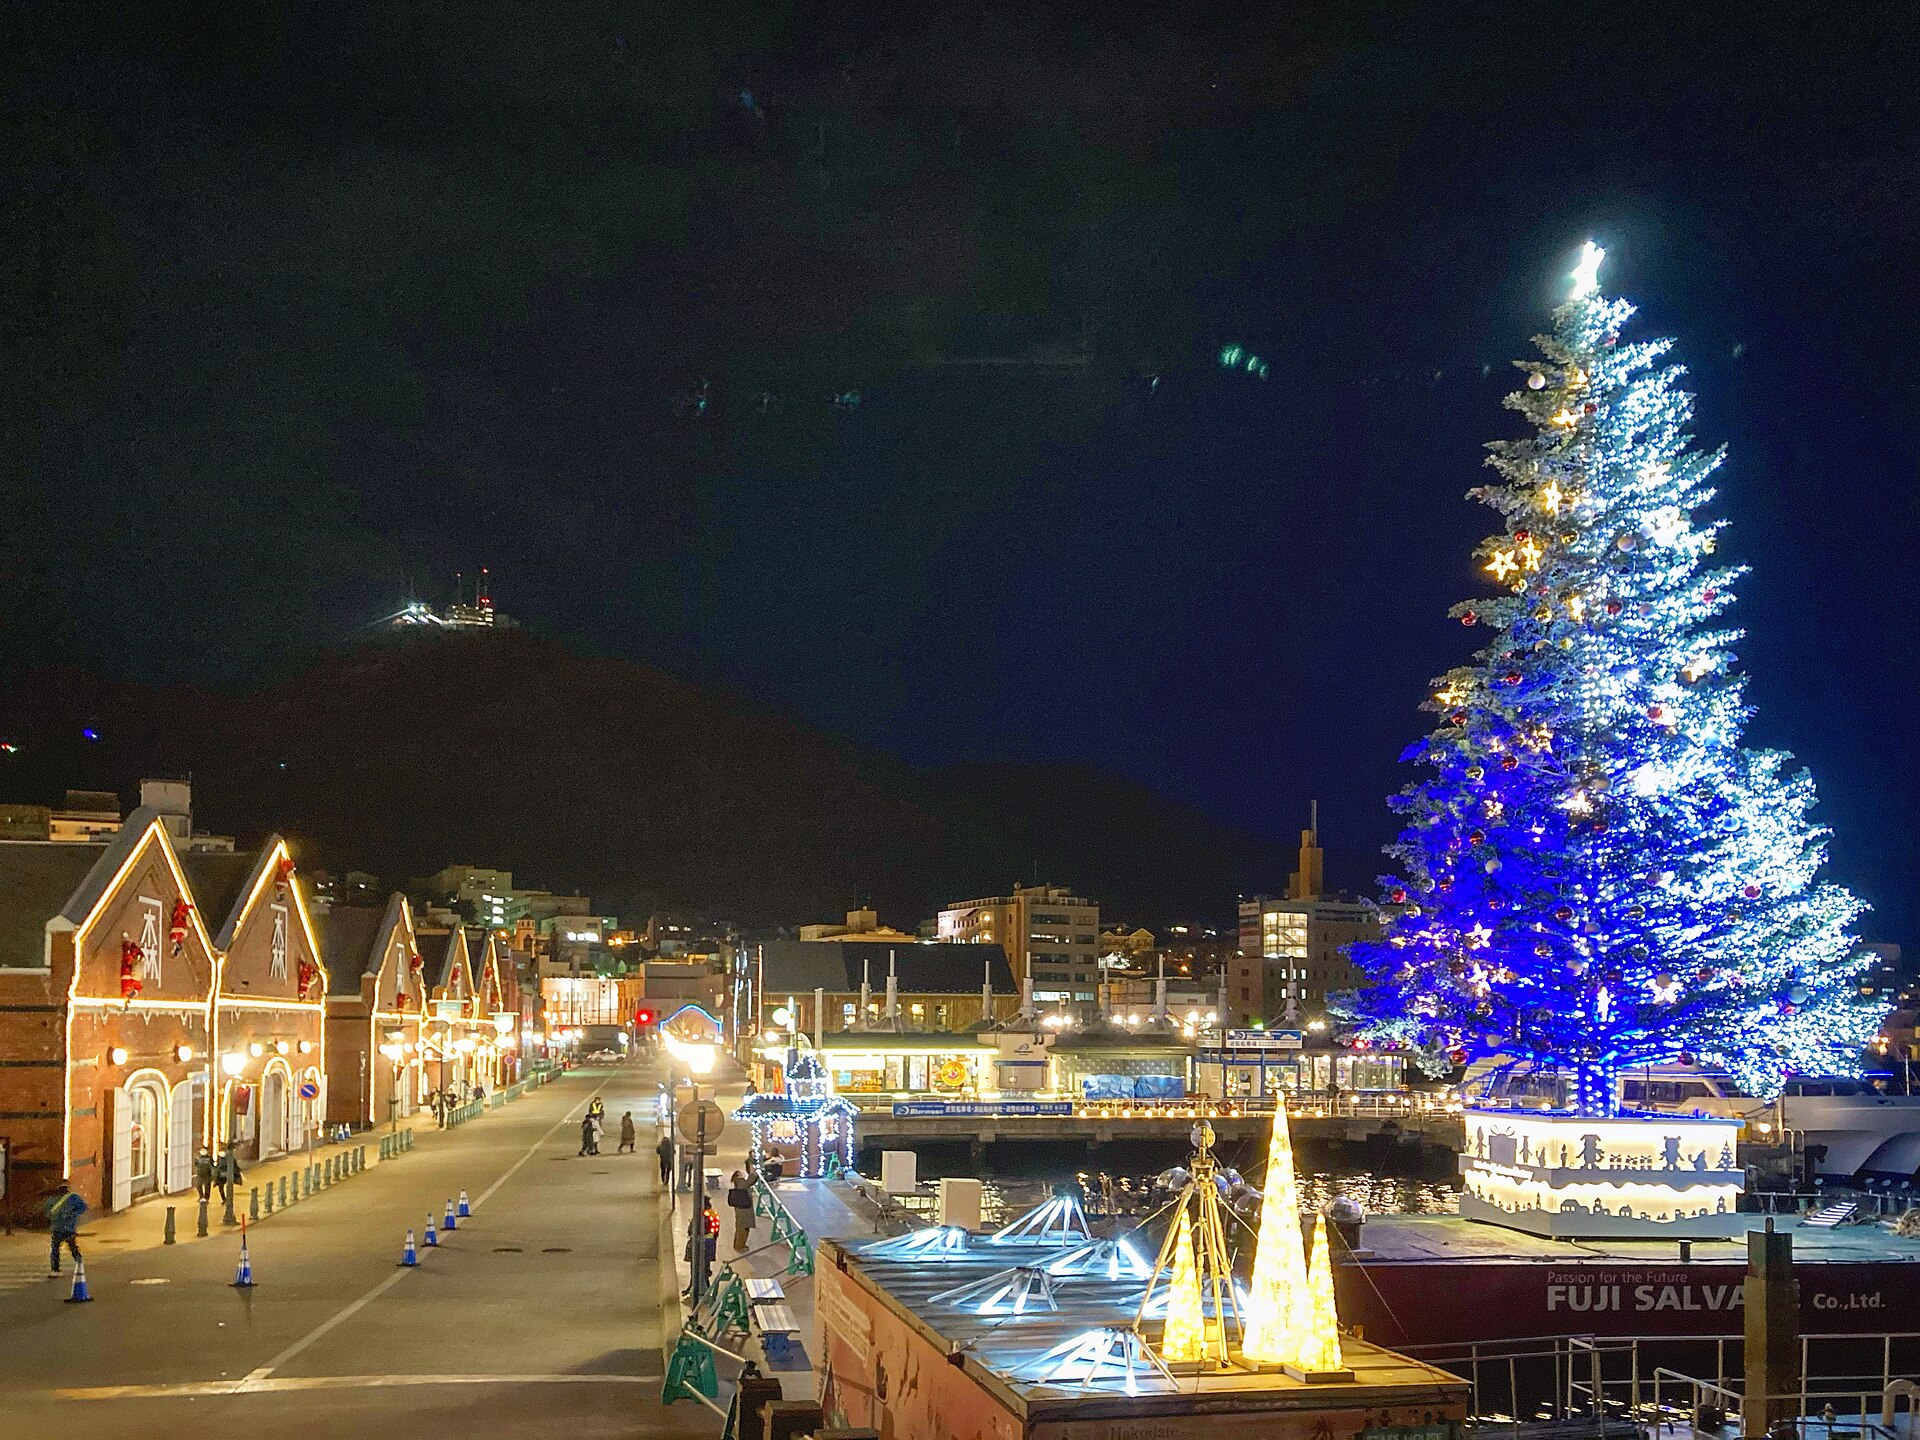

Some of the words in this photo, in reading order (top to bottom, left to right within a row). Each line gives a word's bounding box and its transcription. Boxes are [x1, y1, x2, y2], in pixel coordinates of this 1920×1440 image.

[1547, 1271, 1595, 1283] Passion
[1599, 1272, 1618, 1283] for
[1622, 1272, 1643, 1283] the
[1646, 1272, 1688, 1283] Future
[1547, 1285, 1621, 1312] FUJI
[1634, 1285, 1801, 1312] SALVA
[1812, 1291, 1886, 1310] Co.,Ltd.
